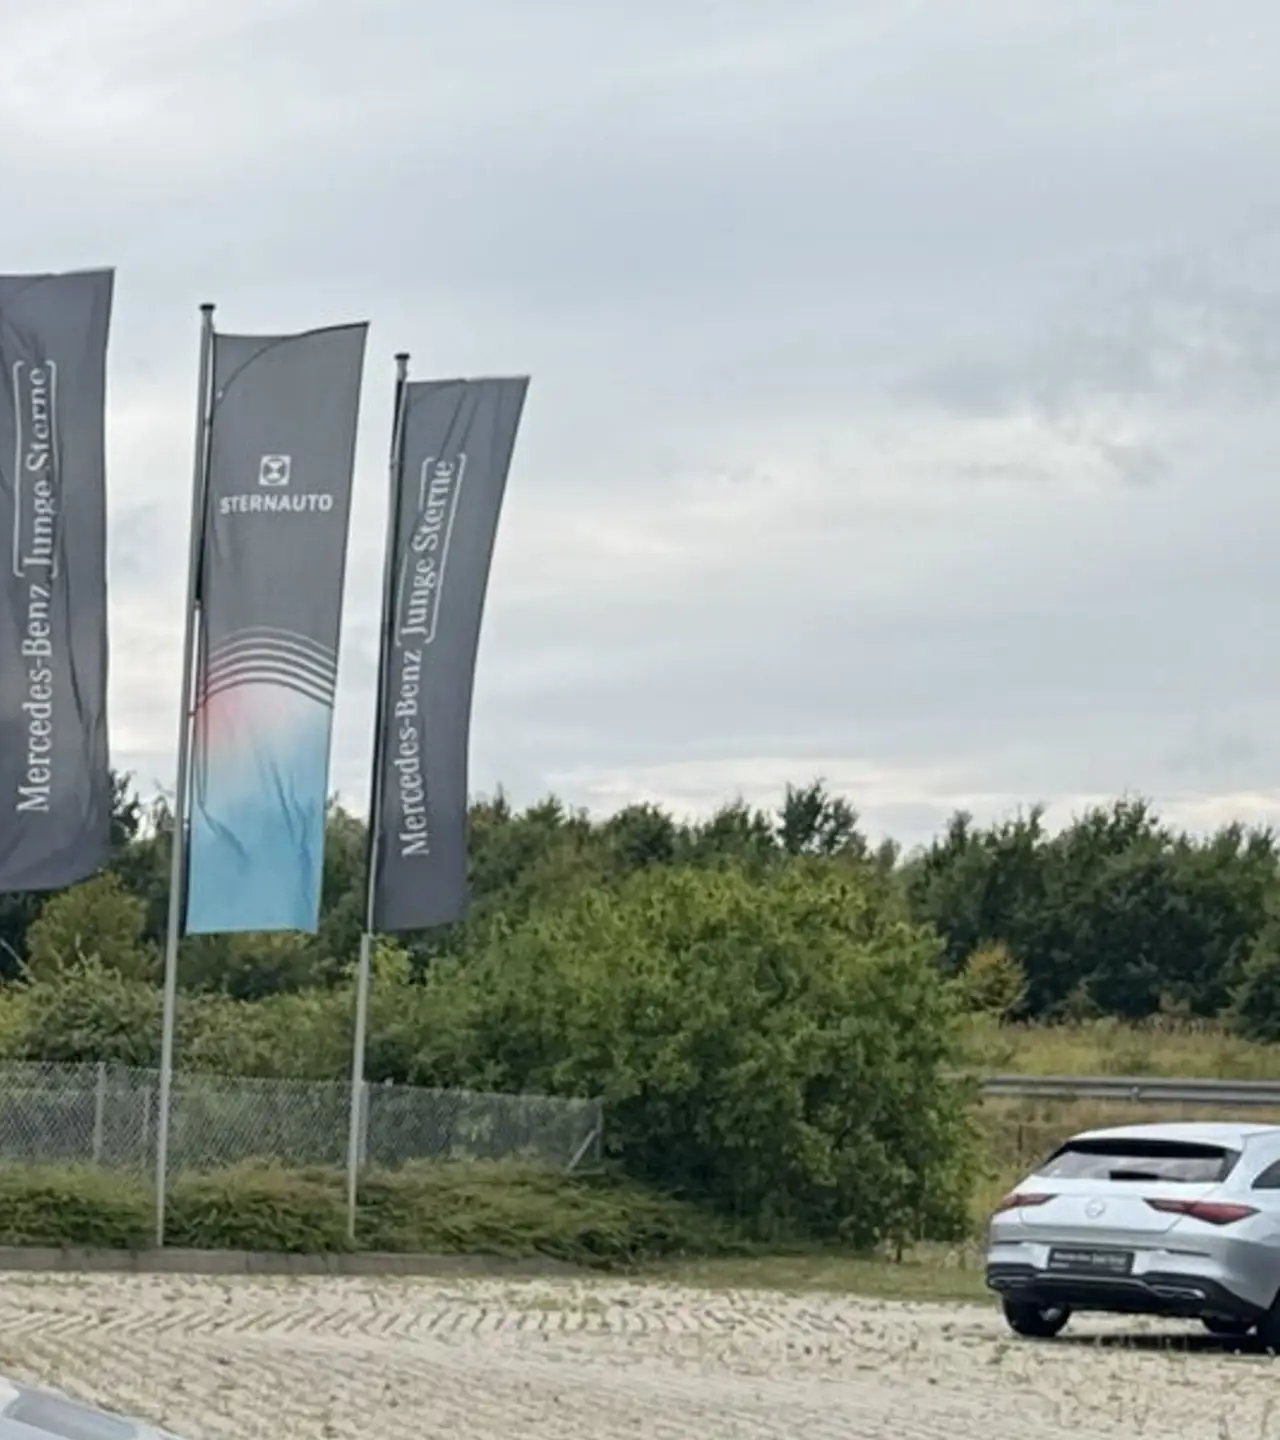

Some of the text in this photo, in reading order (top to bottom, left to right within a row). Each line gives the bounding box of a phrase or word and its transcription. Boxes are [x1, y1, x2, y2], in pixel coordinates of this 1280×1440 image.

[16, 368, 56, 813] Mercedes-Benz Junge Sterne
[220, 494, 333, 514] STERNAUTO
[393, 460, 454, 857] Mercedes-Benz Junge Sterne
